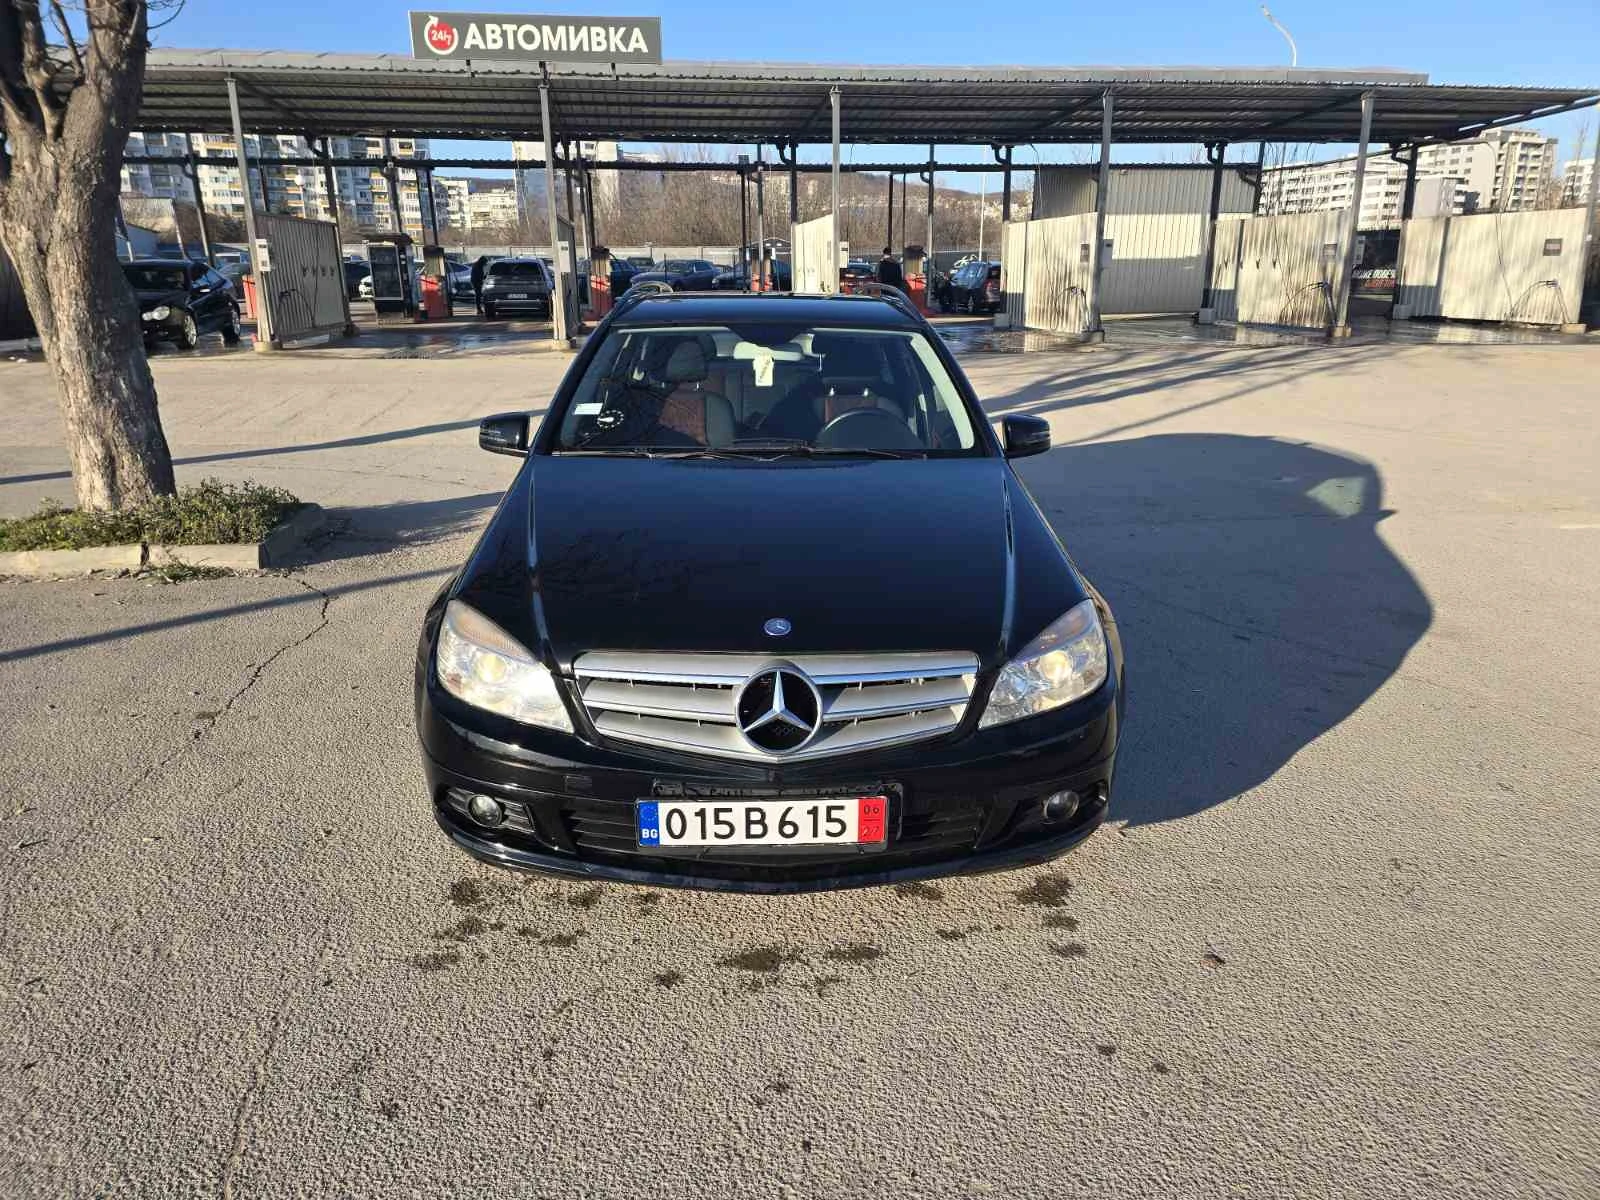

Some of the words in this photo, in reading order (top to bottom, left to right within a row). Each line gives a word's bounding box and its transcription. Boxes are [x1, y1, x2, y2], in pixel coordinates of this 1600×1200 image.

[464, 23, 649, 53] АВТОМИВКА
[642, 828, 658, 839] BG
[665, 805, 847, 840] 015B615
